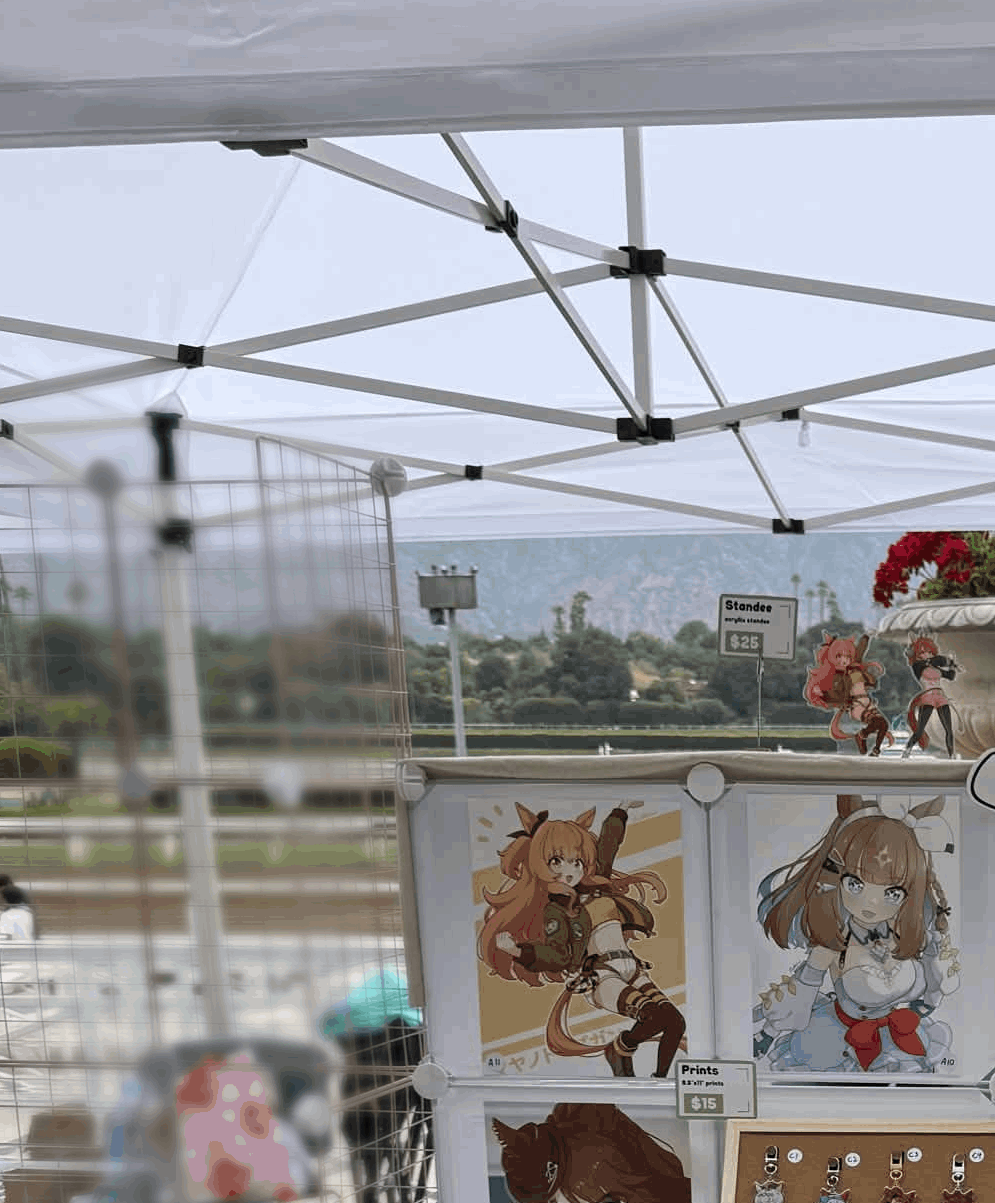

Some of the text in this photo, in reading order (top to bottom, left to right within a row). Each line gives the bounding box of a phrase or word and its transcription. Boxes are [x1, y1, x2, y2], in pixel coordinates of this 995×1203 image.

[725, 600, 772, 613] Standee
[730, 634, 759, 650] $25
[682, 1065, 719, 1075] Prints
[691, 1095, 717, 1111] $15
